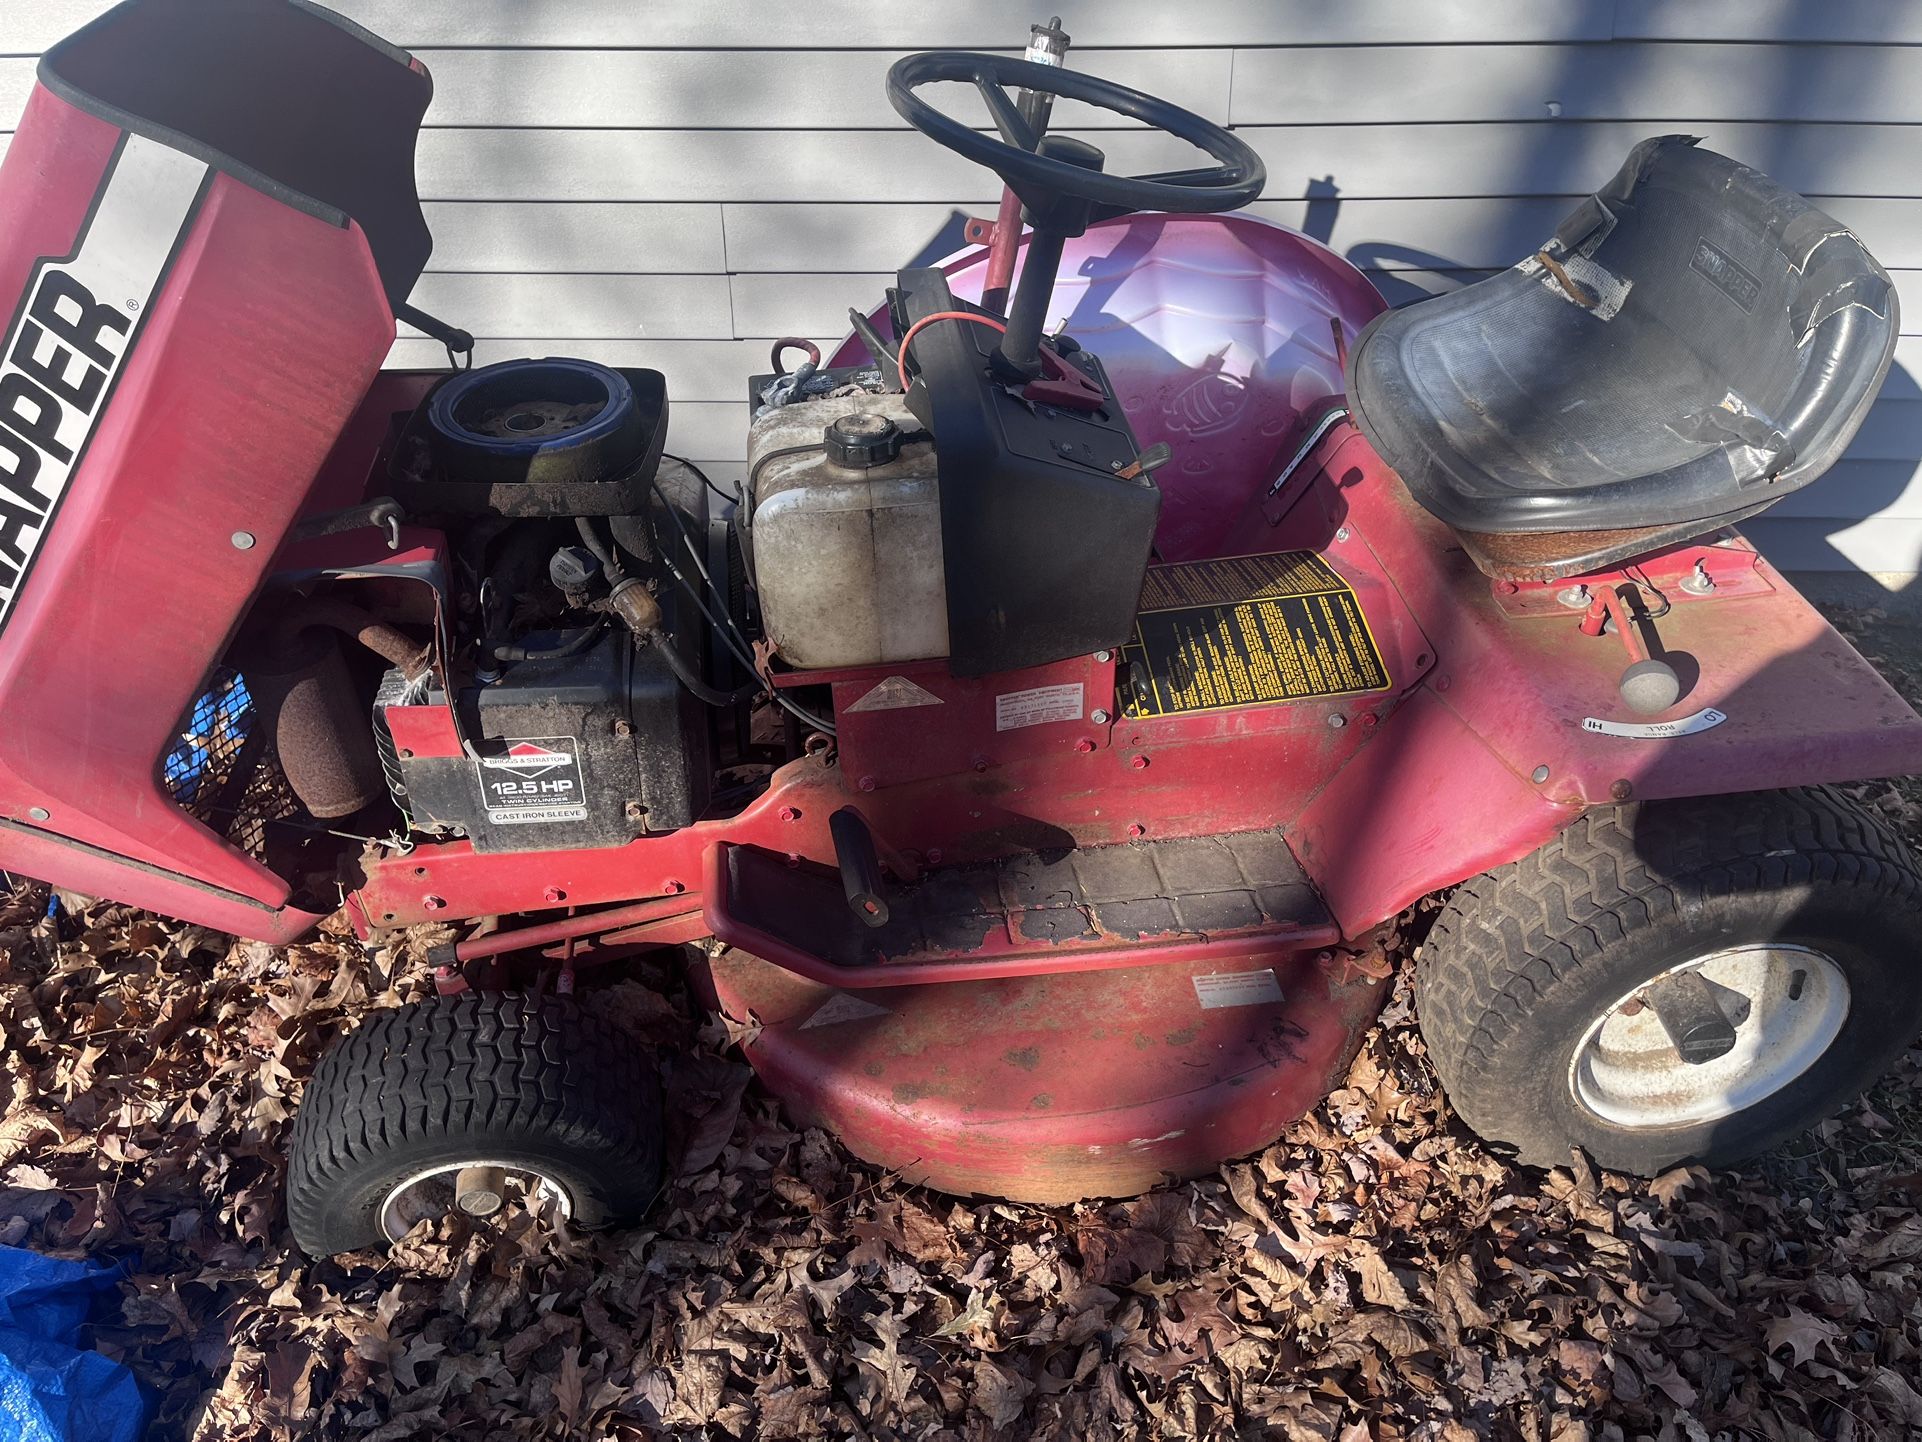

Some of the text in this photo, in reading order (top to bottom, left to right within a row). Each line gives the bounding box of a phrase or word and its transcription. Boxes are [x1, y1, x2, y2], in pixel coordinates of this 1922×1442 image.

[1704, 710, 1722, 722] LO
[1588, 720, 1603, 730] HI
[1647, 724, 1676, 732] ROLL
[491, 779, 573, 795] 12.5 HP
[522, 811, 545, 819] IRON
[546, 810, 582, 818] SLEEVE
